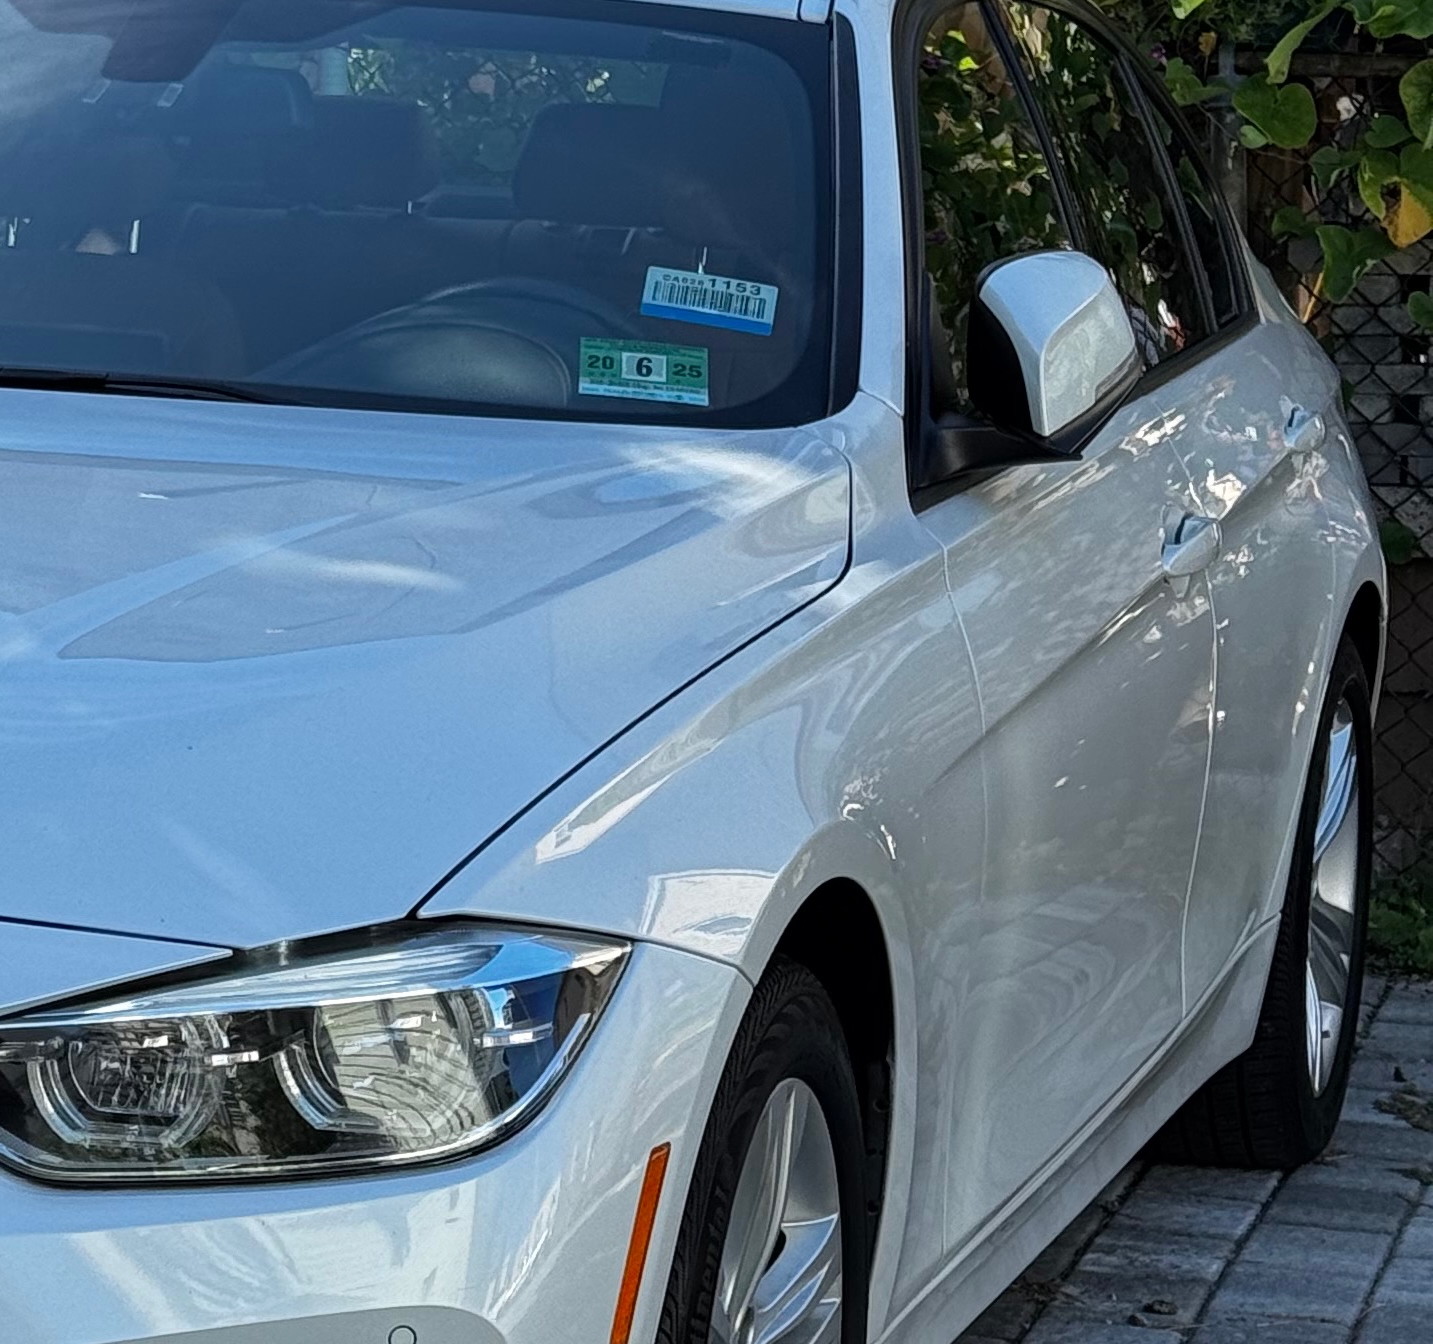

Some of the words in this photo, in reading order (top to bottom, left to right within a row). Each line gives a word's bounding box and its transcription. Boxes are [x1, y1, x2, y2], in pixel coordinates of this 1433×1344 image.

[587, 354, 615, 370] 20
[636, 357, 653, 377] 6
[672, 362, 703, 378] 25
